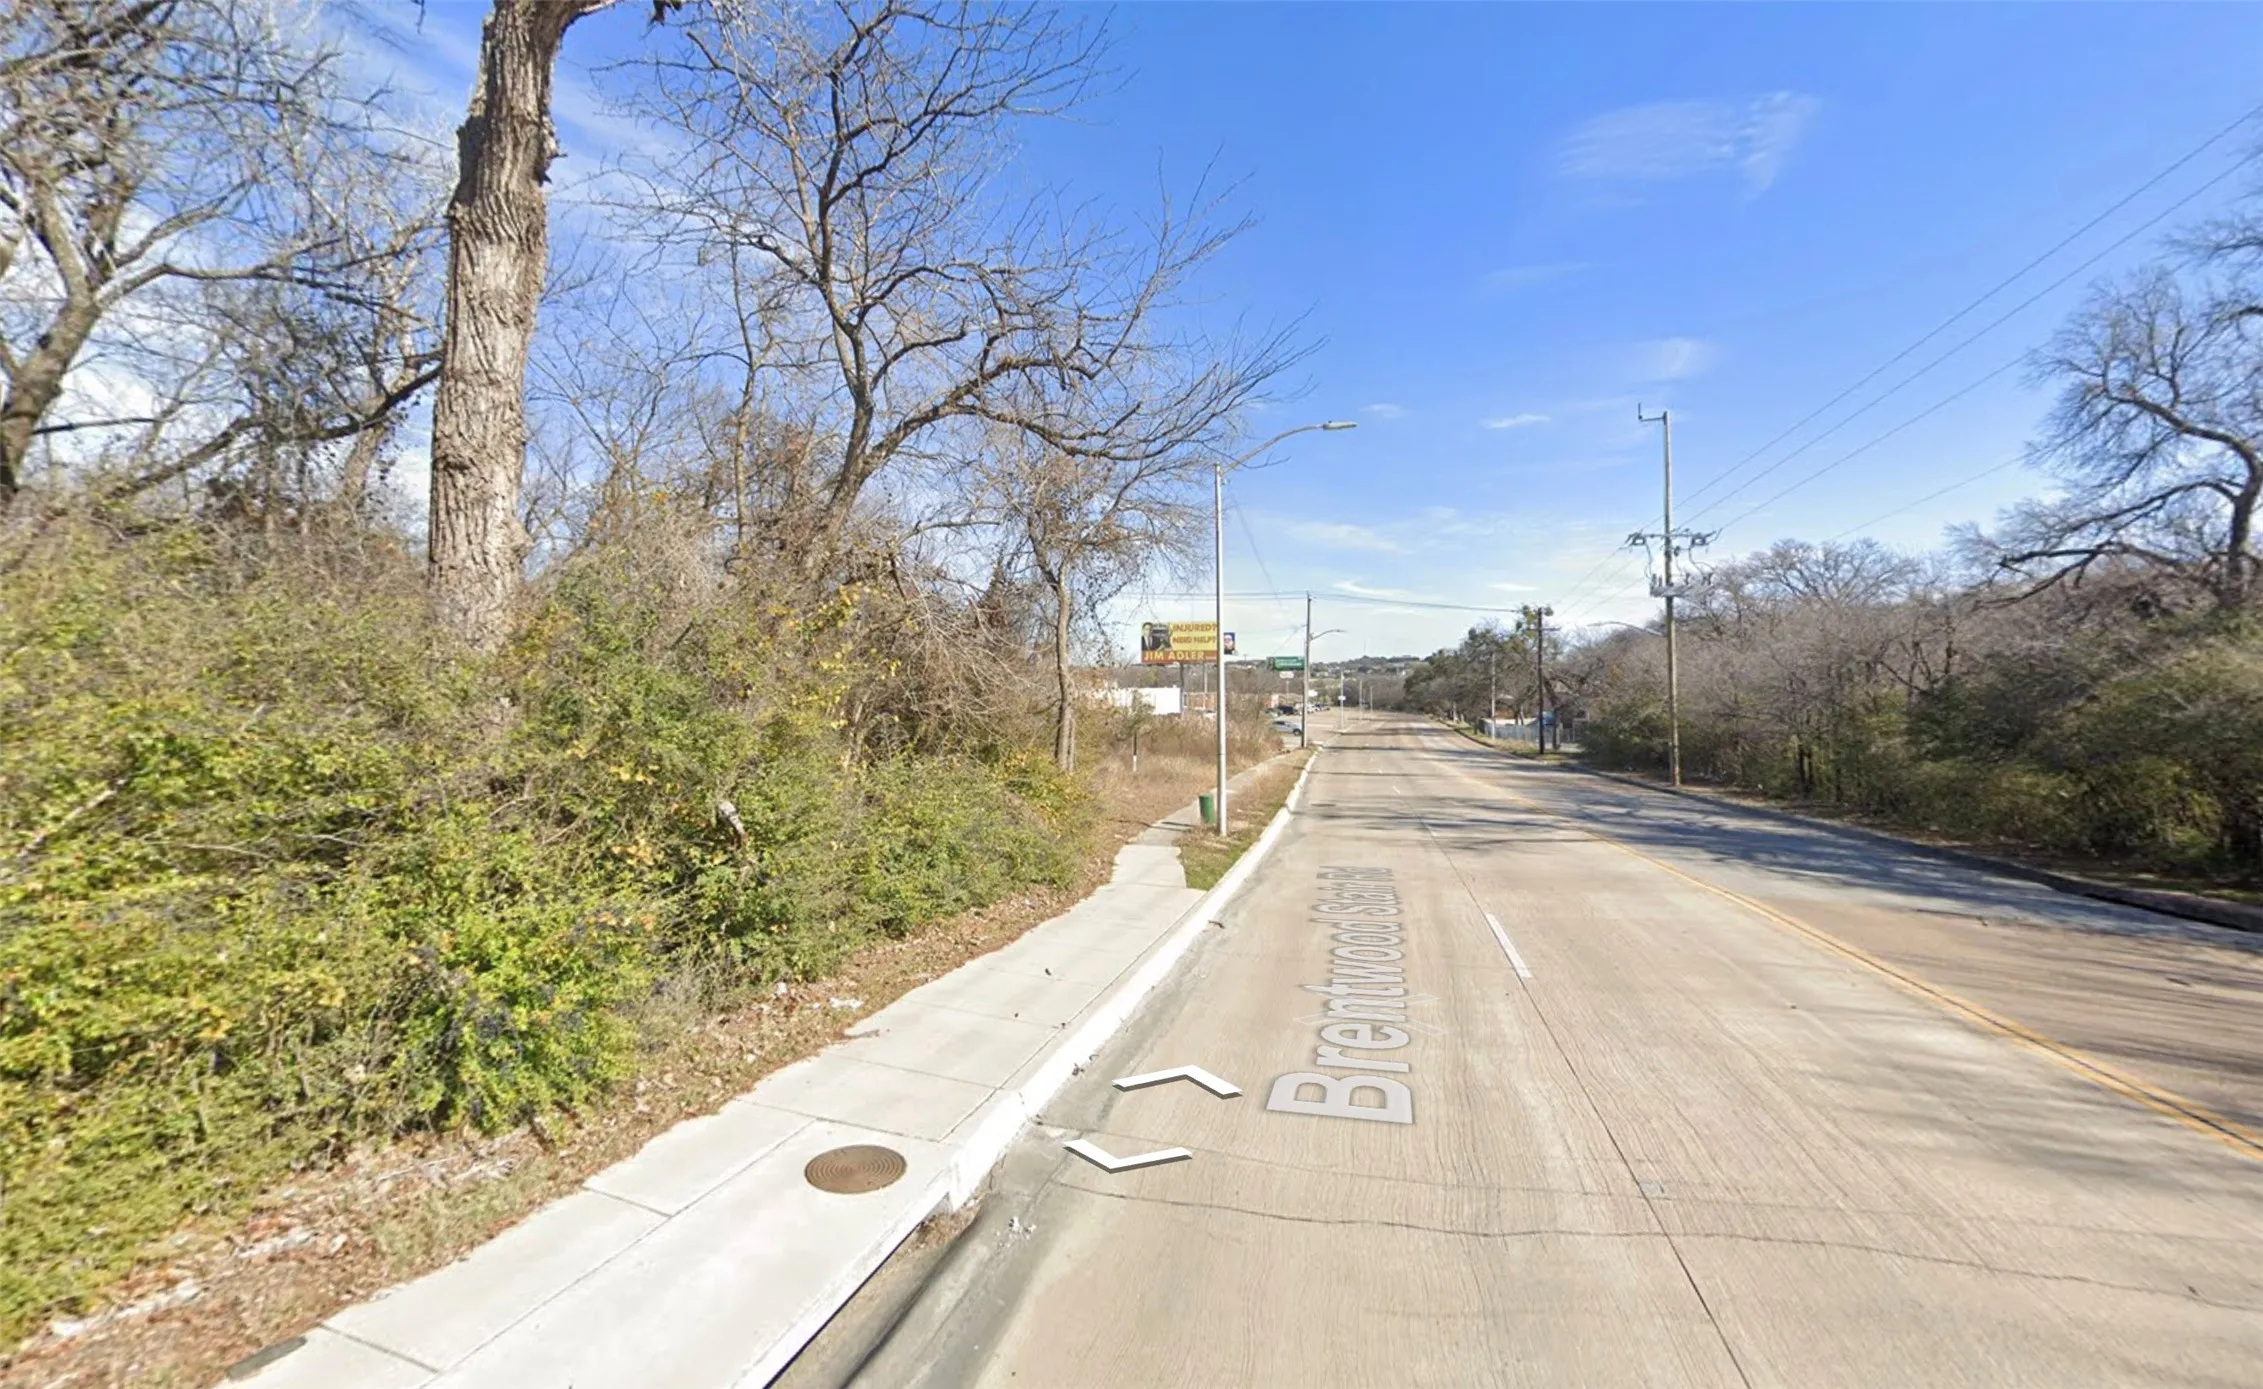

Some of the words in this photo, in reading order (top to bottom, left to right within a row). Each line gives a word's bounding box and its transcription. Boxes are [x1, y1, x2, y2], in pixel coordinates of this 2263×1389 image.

[1173, 623, 1216, 632] INJURED?
[1144, 651, 1164, 660] JIM
[1168, 651, 1205, 660] ADLER
